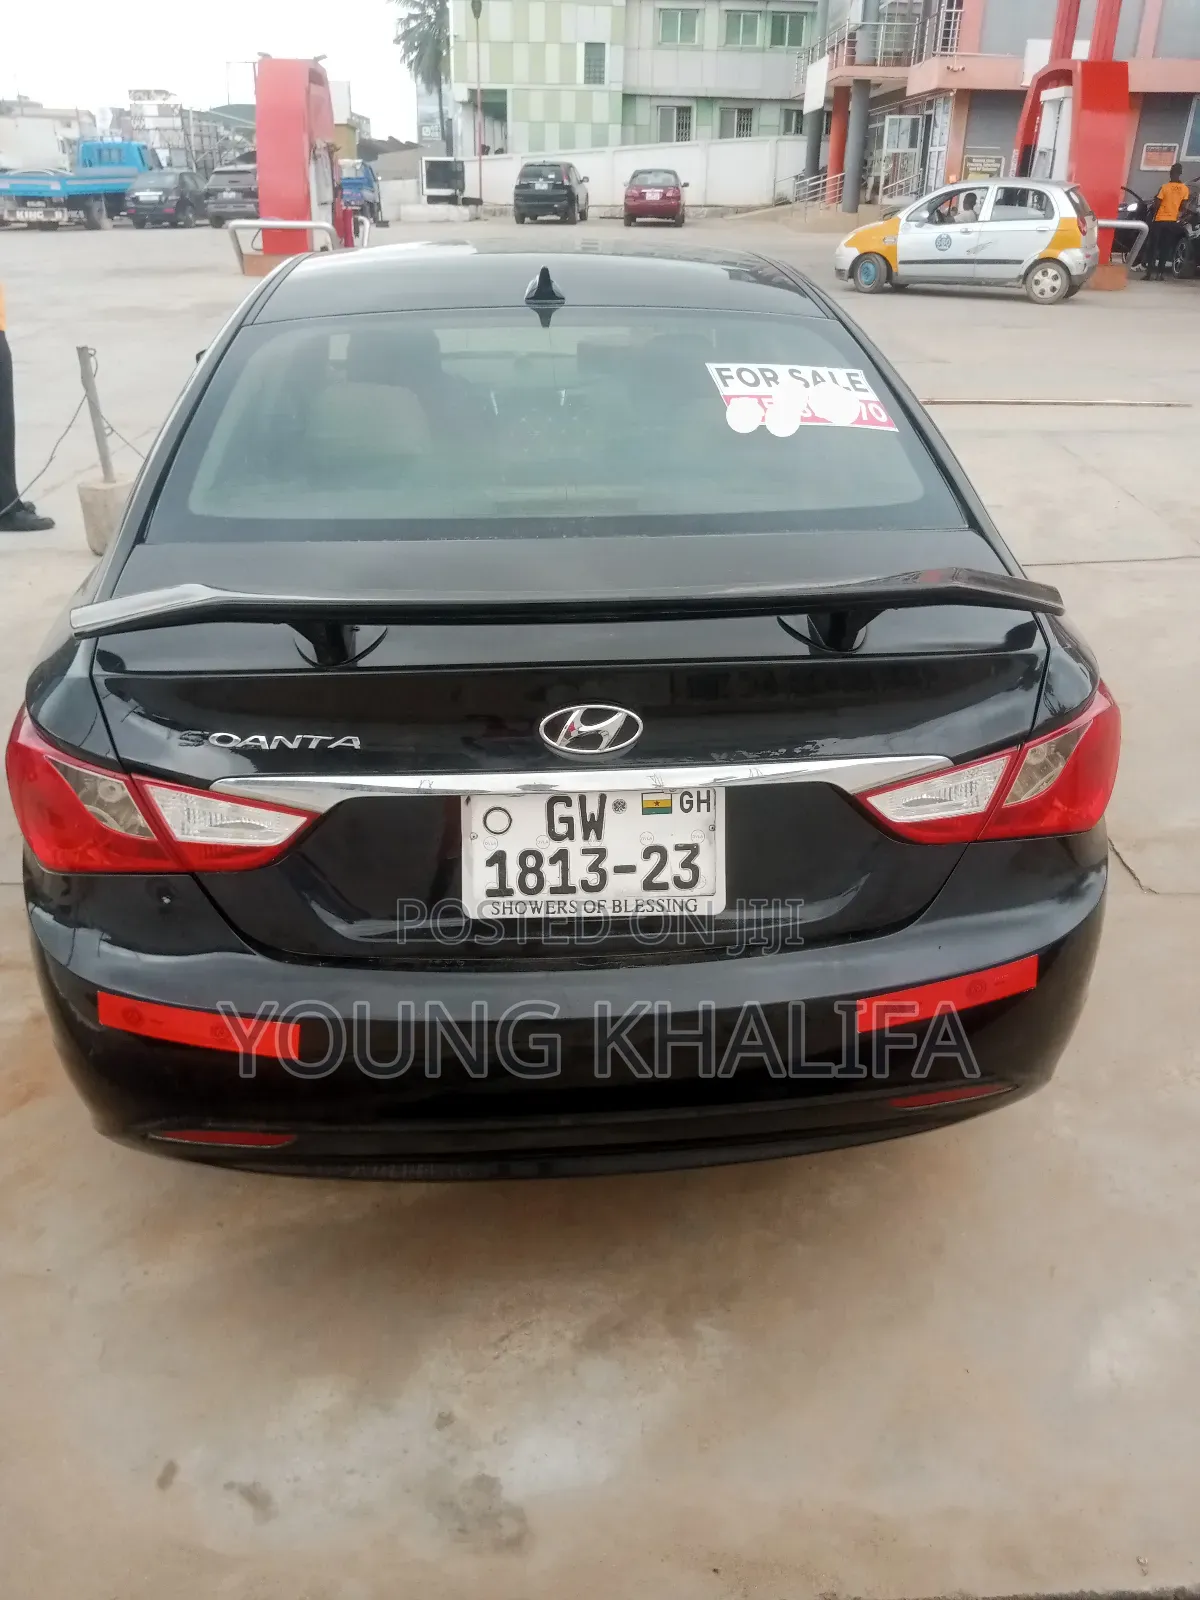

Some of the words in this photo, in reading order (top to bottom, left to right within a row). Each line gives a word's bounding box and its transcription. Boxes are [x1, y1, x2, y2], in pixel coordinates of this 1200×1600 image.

[16, 210, 45, 220] KING
[714, 367, 780, 388] FOR
[788, 368, 869, 393] SALE
[679, 789, 711, 814] GH
[546, 793, 608, 842] GW
[485, 843, 701, 897] 1813-23
[491, 900, 578, 916] SHOWERS
[583, 900, 607, 915] OF
[611, 898, 699, 915] BLESSING
